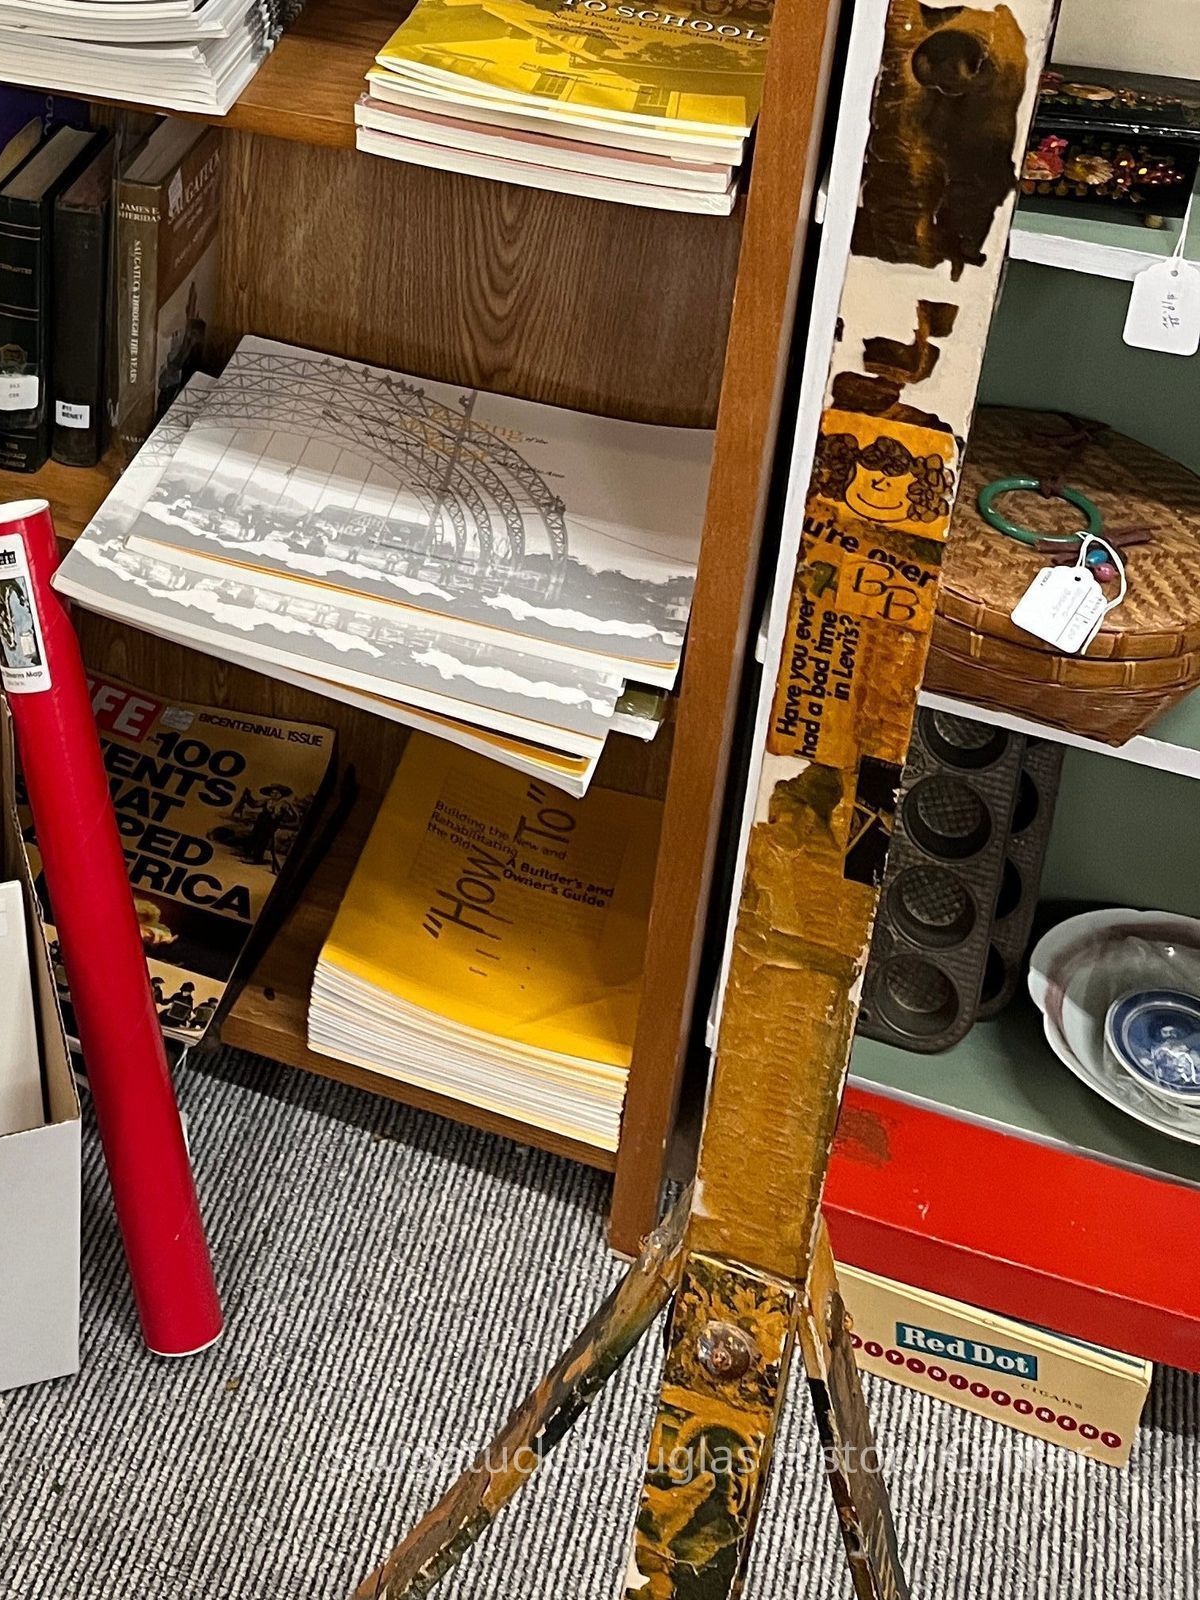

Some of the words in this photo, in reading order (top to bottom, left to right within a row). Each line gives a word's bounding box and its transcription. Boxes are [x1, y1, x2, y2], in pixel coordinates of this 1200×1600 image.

[615, 4, 767, 42] SCHOOL
[638, 20, 680, 36] Union
[120, 202, 152, 215] JAMES
[867, 548, 938, 588] over
[796, 596, 816, 639] ever
[876, 584, 921, 622] B
[812, 610, 839, 656] time
[26, 670, 44, 680] Map
[790, 642, 812, 684] you
[802, 654, 830, 700] bad
[776, 684, 802, 737] Have
[808, 703, 824, 718] a
[827, 684, 850, 702] in
[198, 711, 286, 741] BICENTENNIAL
[286, 729, 324, 748] ISSUE
[794, 718, 822, 759] had
[154, 730, 247, 779] 100
[427, 822, 448, 838] the
[450, 833, 472, 850] Old
[430, 811, 519, 860] Rehabilitating
[434, 800, 486, 833] Building
[488, 824, 510, 841] the
[542, 844, 568, 861] and
[502, 868, 559, 896] Owner's
[561, 888, 606, 909] Guide
[505, 858, 517, 870] A
[520, 862, 583, 890] Builder's
[586, 882, 616, 899] and
[902, 1324, 965, 1359] Red
[970, 1344, 1030, 1376] Dot
[1020, 1382, 1084, 1410] CIGARS
